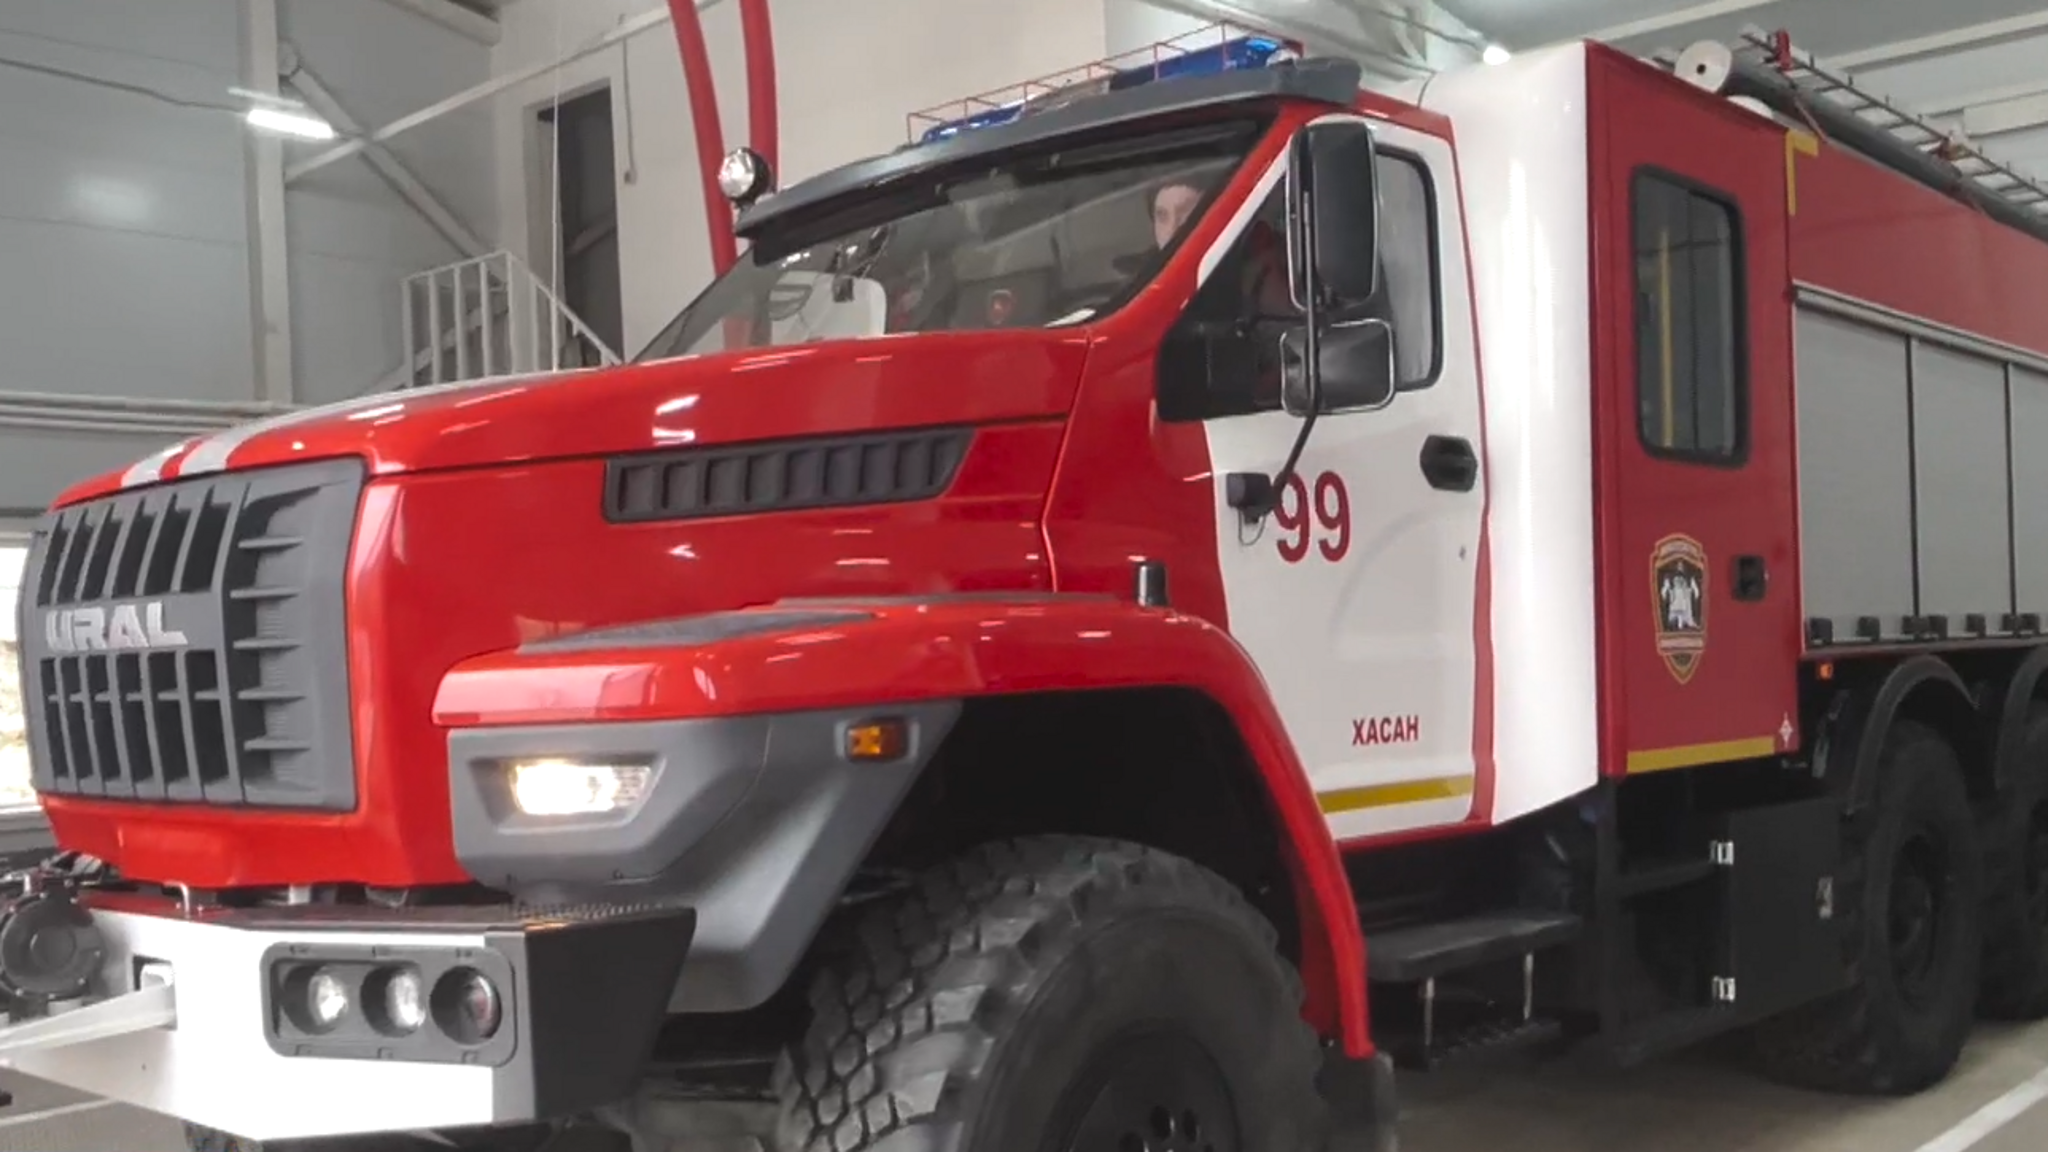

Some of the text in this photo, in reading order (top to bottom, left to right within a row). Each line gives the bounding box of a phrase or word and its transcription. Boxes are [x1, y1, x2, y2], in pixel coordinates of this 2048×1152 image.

[1273, 470, 1350, 562] 99
[46, 601, 188, 651] URAL
[1352, 715, 1419, 746] ХАСАН
